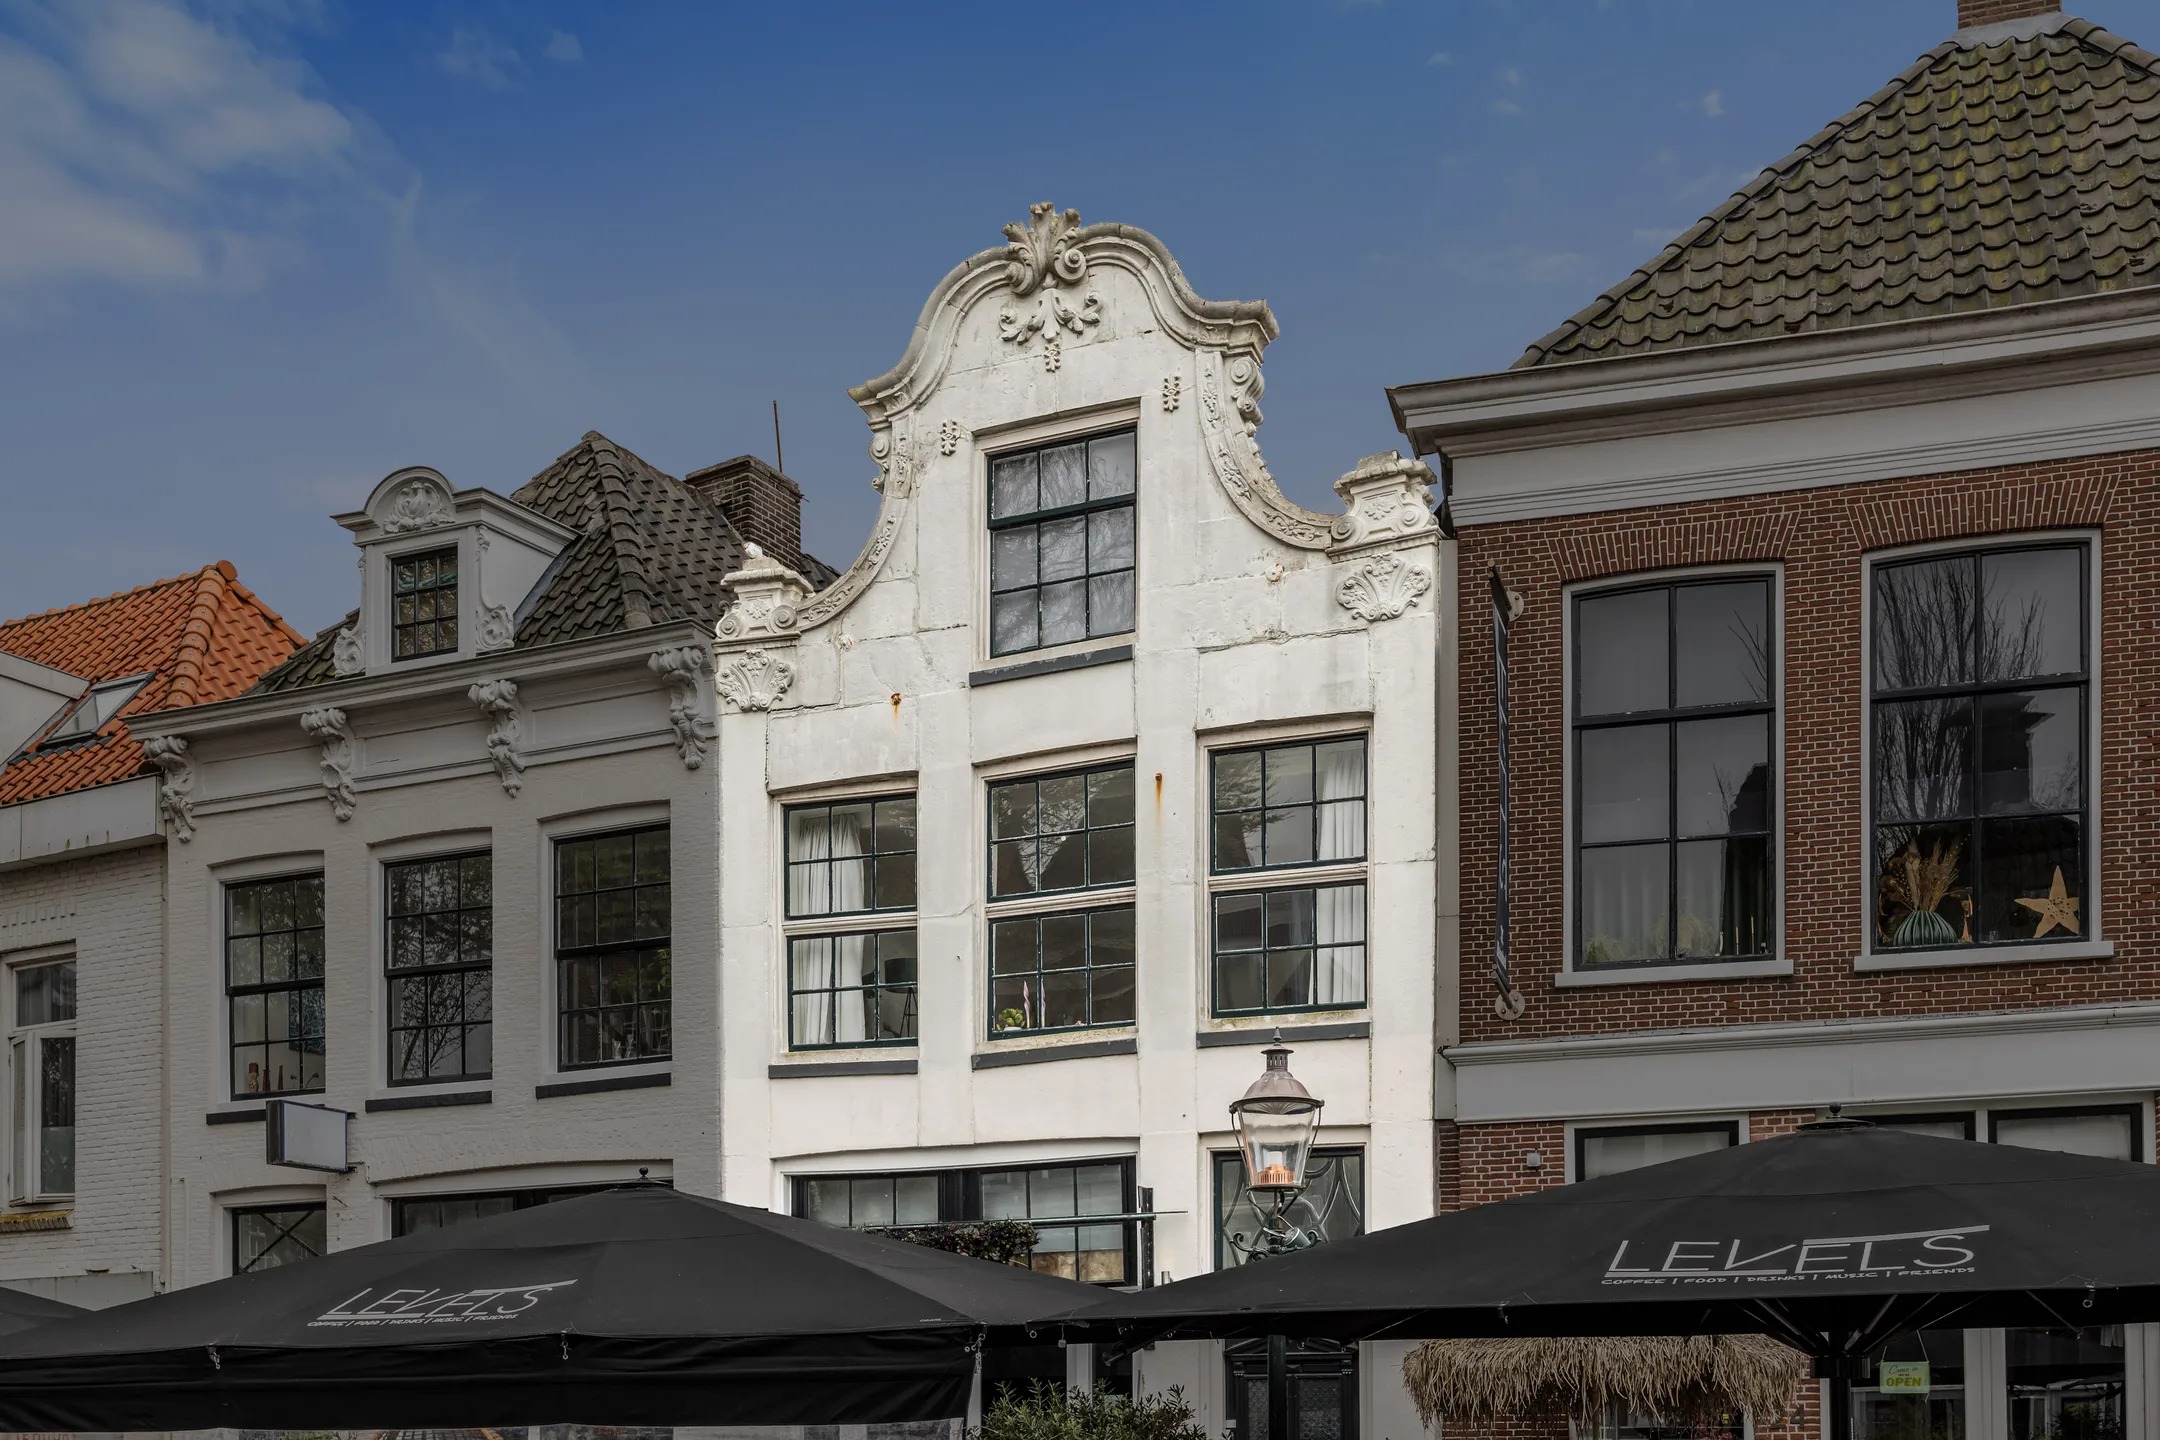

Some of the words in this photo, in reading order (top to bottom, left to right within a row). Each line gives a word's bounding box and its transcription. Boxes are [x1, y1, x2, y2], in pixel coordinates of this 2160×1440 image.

[1606, 1233, 1978, 1274] LEVELS
[1898, 1267, 1976, 1276] FRIENDS
[319, 1284, 558, 1318] LEVELS
[472, 1313, 519, 1321] FRIENDS
[1886, 1377, 1922, 1387] OPEN
